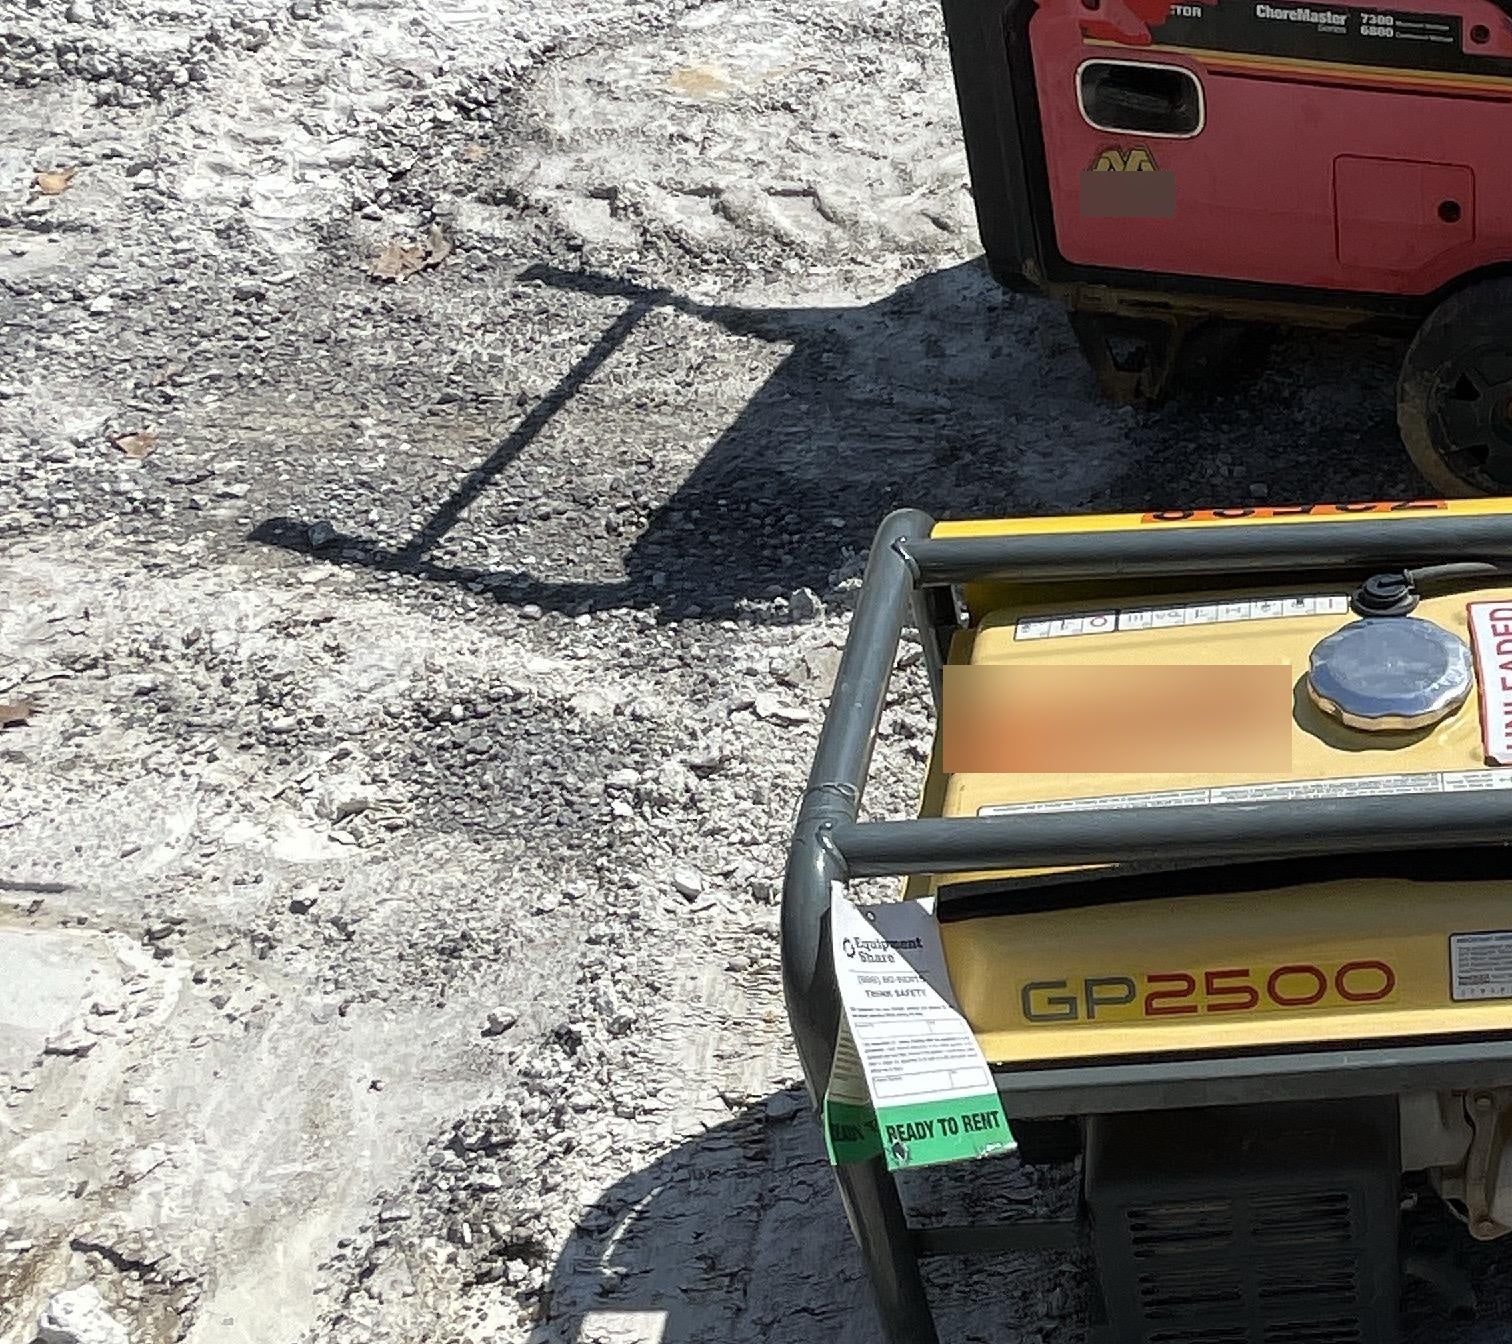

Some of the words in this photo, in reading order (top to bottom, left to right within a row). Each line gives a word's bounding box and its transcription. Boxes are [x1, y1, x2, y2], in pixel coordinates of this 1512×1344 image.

[1256, 4, 1348, 25] ChoreMaster
[855, 936, 924, 953] Equipment
[859, 951, 896, 964] Share
[1021, 959, 1396, 1023] GP2500
[885, 1118, 934, 1144] READY
[937, 1116, 959, 1136] TO
[961, 1110, 1000, 1133] RENT
